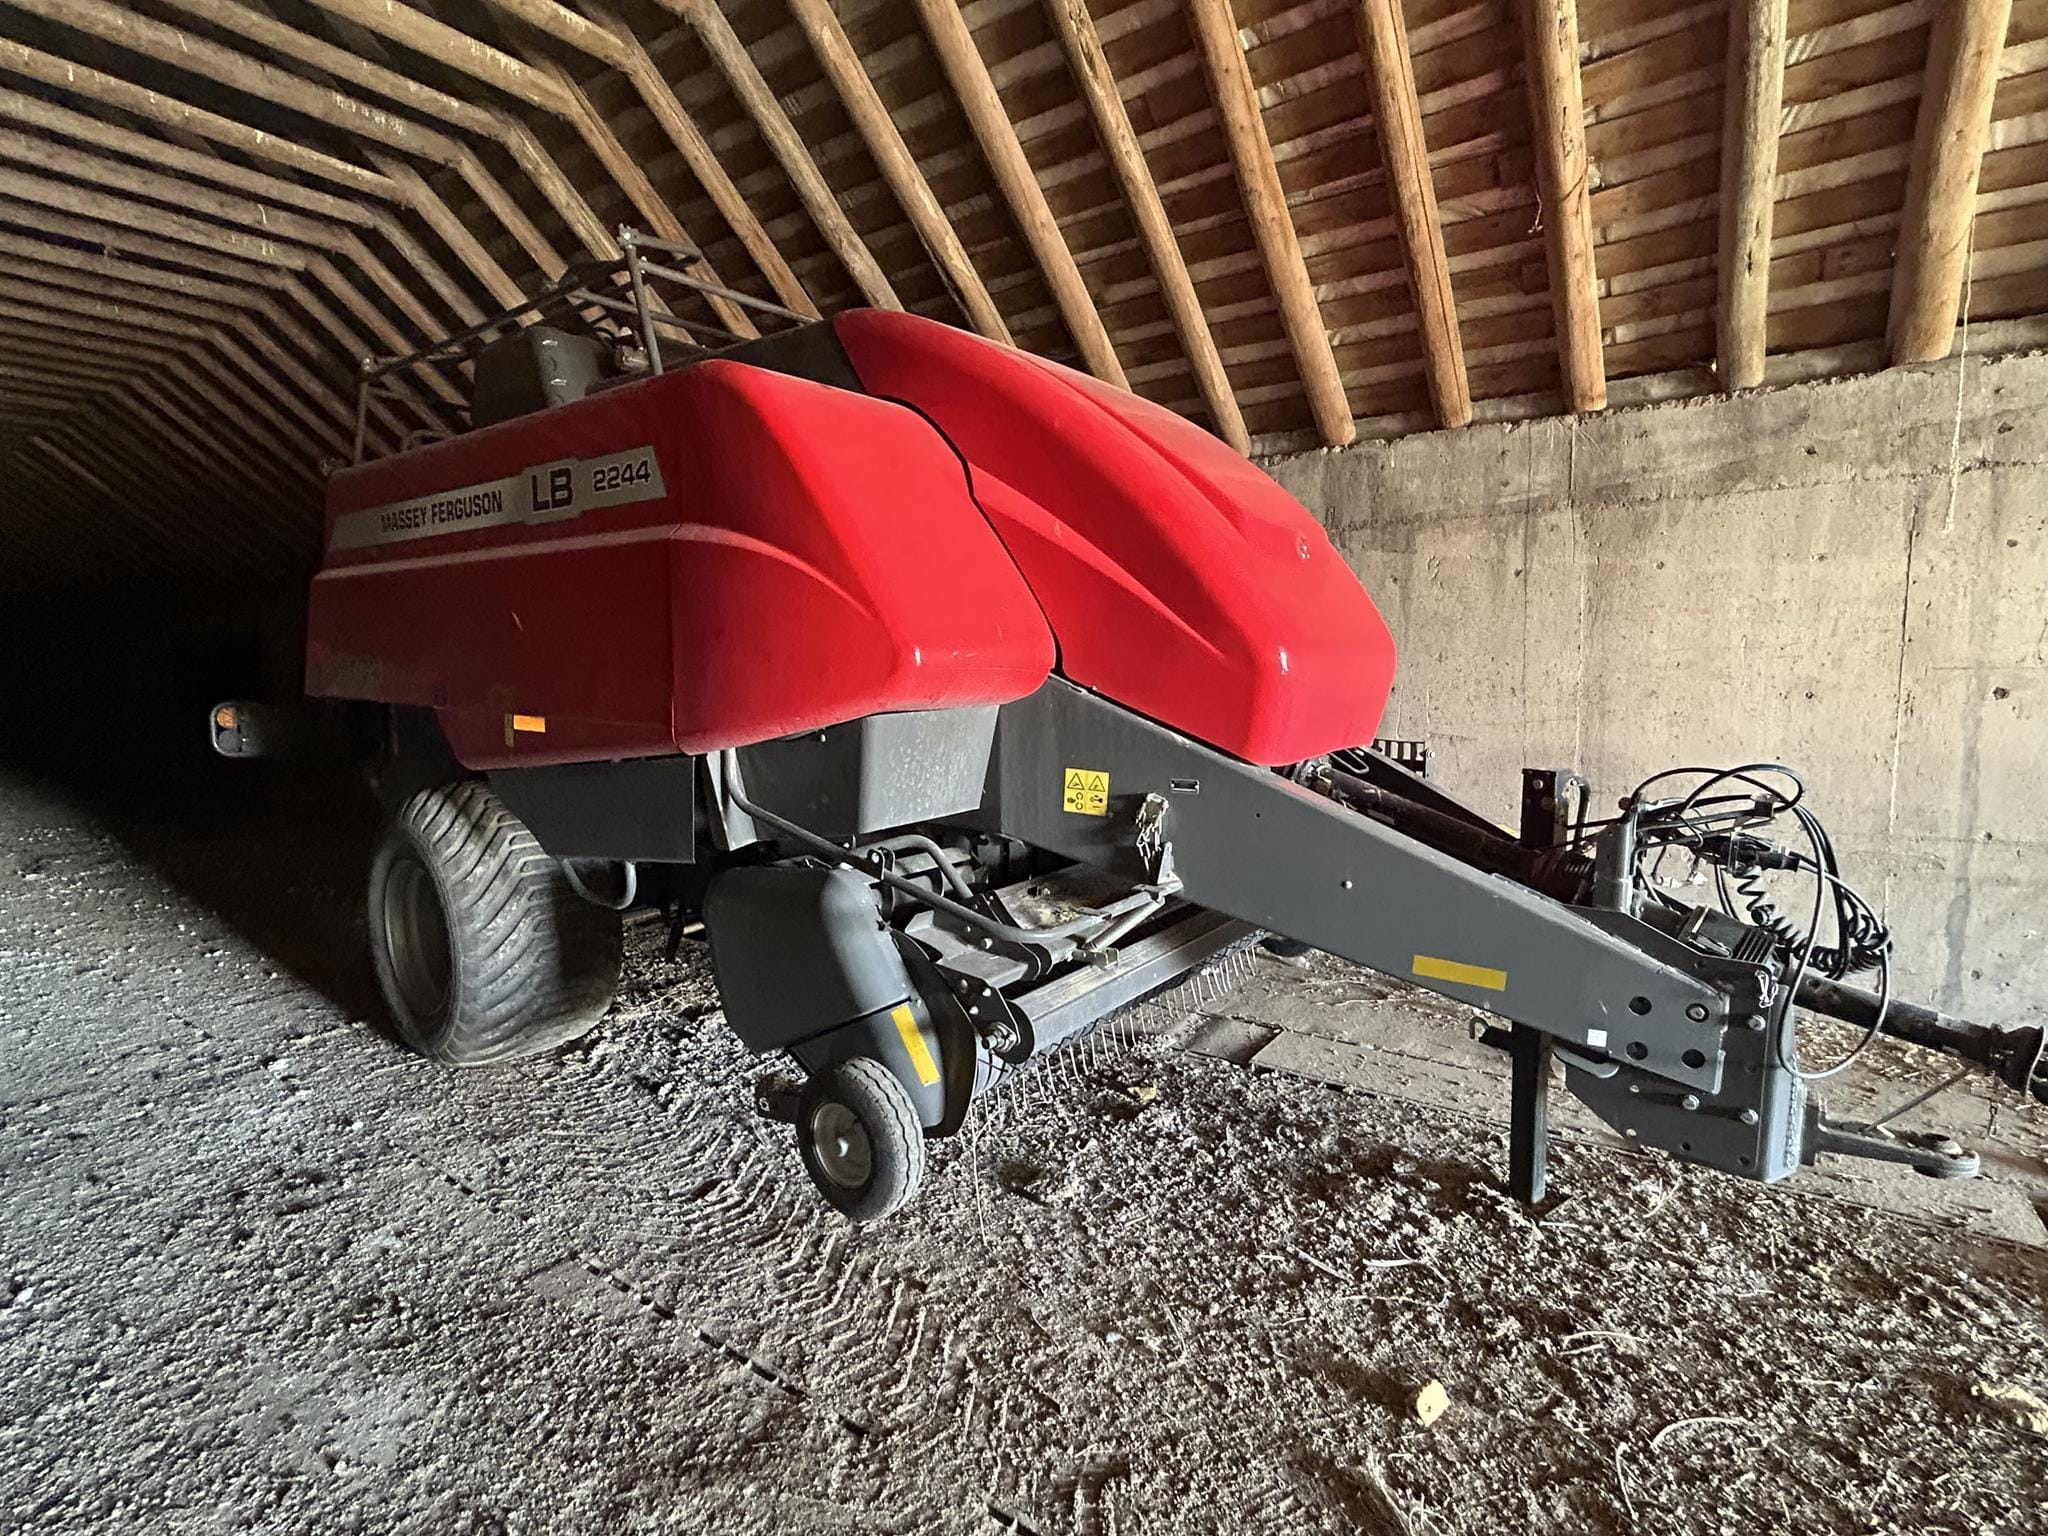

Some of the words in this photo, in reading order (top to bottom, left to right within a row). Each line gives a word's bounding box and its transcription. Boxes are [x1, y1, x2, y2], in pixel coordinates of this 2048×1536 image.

[380, 505, 428, 531] MASSEY
[432, 491, 502, 523] FERGUSON
[531, 467, 573, 512] LB
[593, 460, 651, 492] 2244
